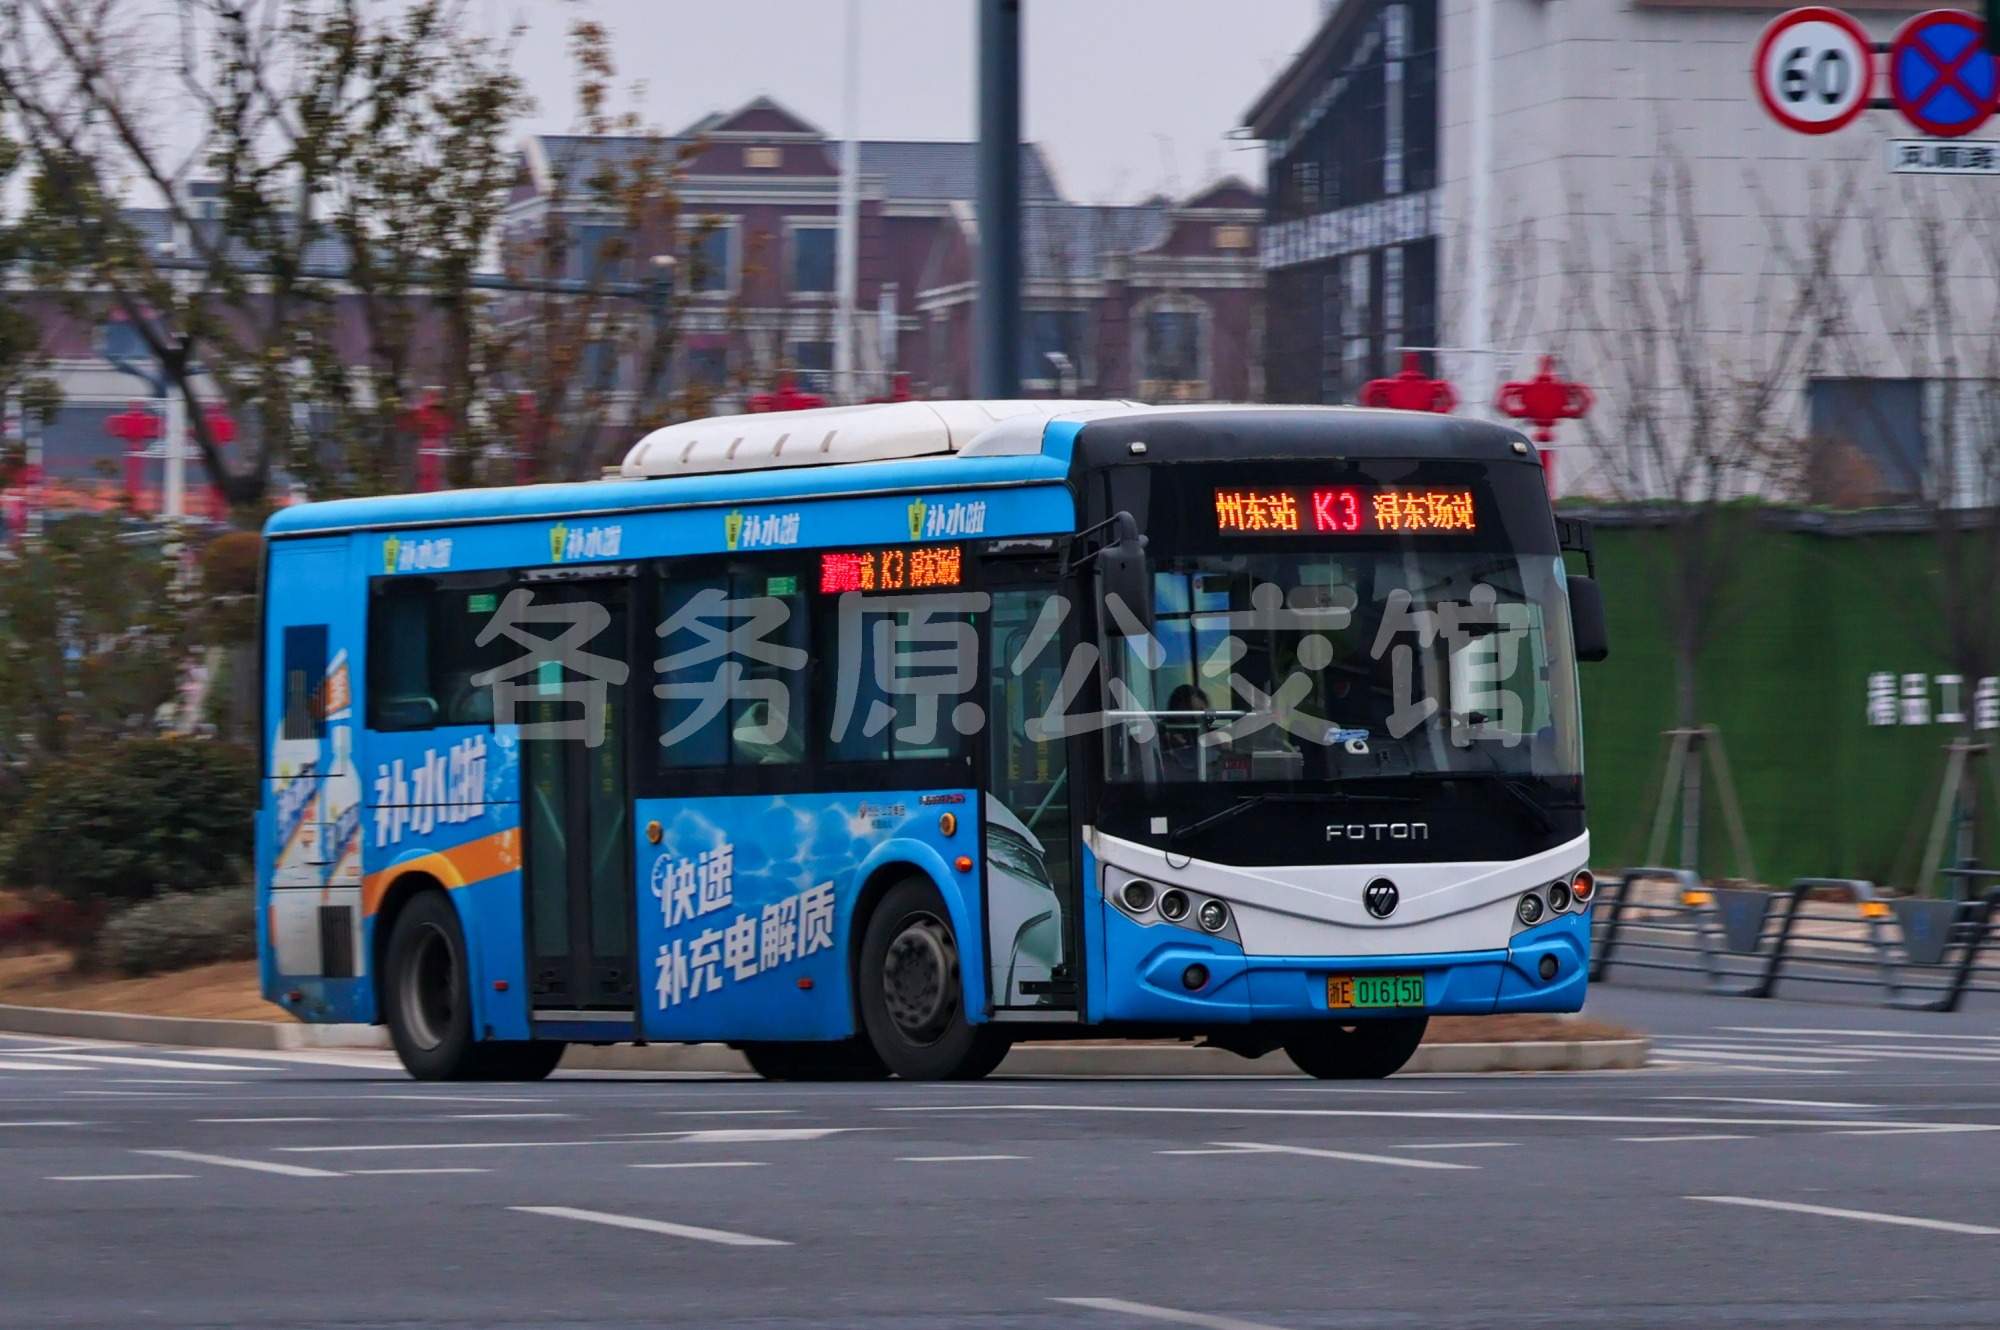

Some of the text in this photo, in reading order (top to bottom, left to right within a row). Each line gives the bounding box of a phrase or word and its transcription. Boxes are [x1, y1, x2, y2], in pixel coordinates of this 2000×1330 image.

[1780, 47, 1850, 104] 60
[743, 513, 800, 547] 补水啦
[927, 501, 987, 537] 补水啦
[1313, 492, 1358, 531] K3
[374, 734, 487, 848] 补水啦
[1326, 823, 1428, 841] FOTON
[660, 842, 734, 929] 快速
[654, 880, 835, 1010] 补充电解质
